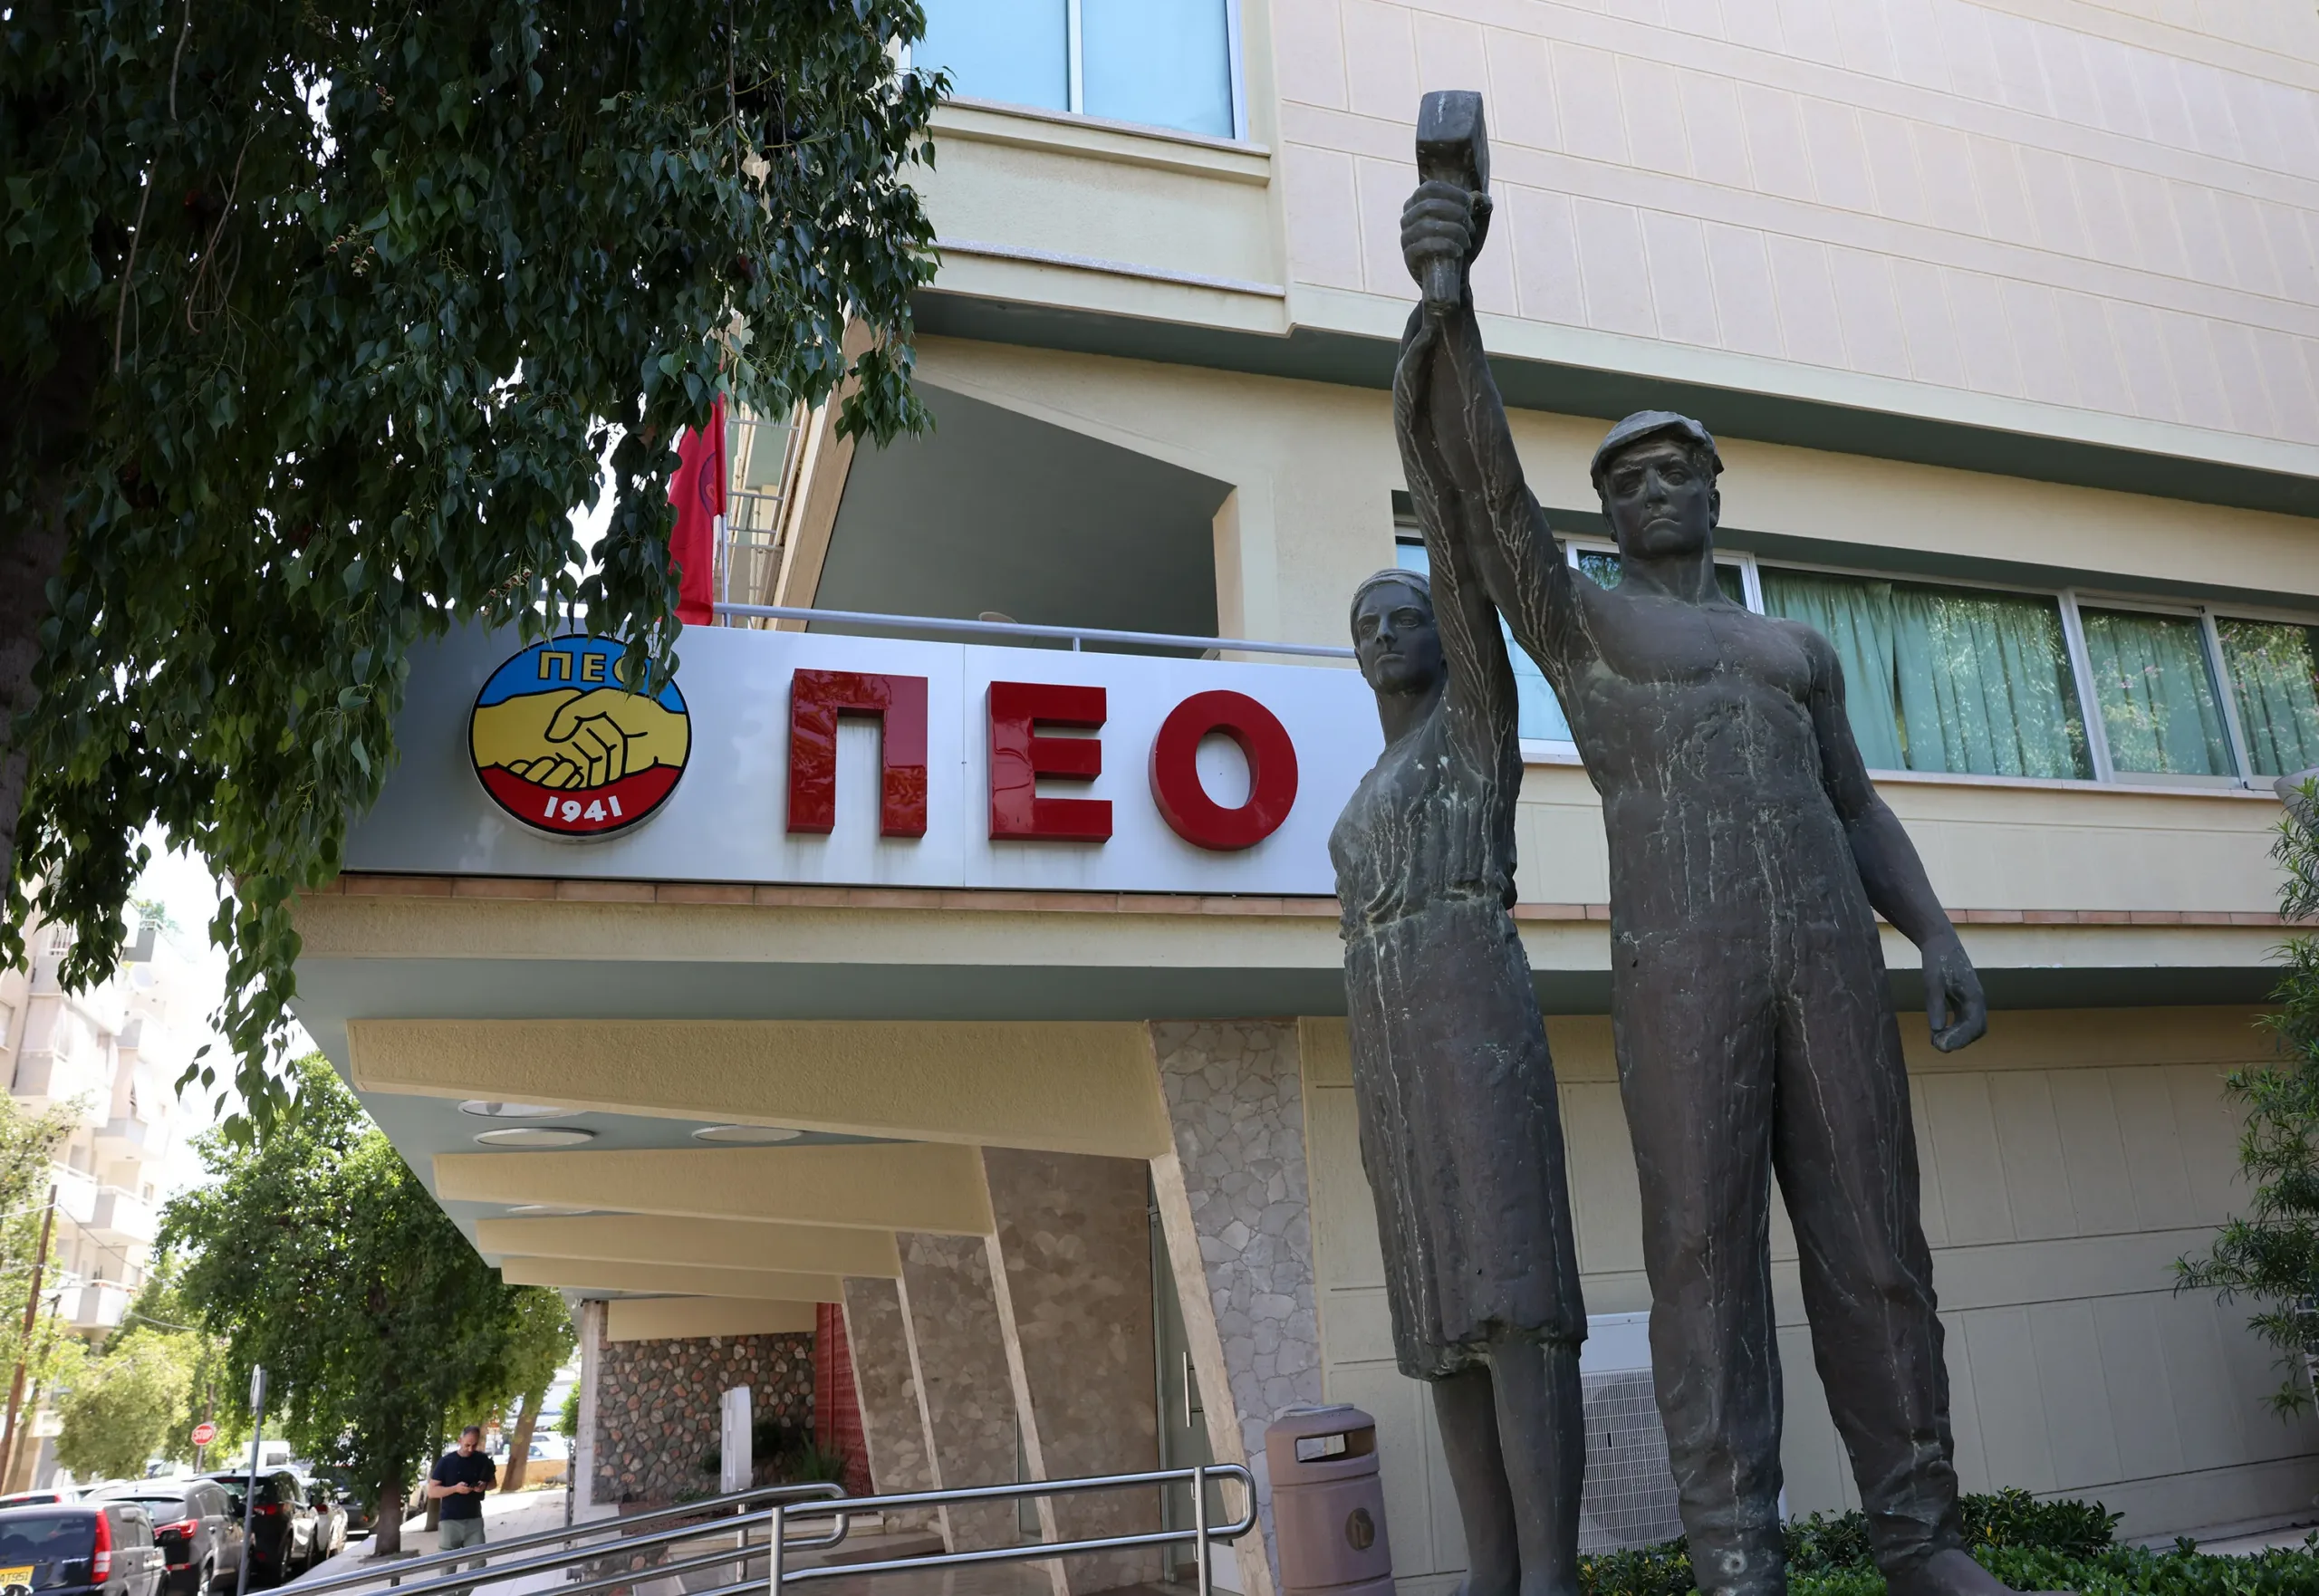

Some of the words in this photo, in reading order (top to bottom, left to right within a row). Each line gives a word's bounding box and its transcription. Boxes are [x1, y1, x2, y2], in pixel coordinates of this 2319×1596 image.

[786, 668, 1298, 851] ΠΕΟ
[544, 795, 622, 822] 1941
[193, 1428, 213, 1440] STOP
